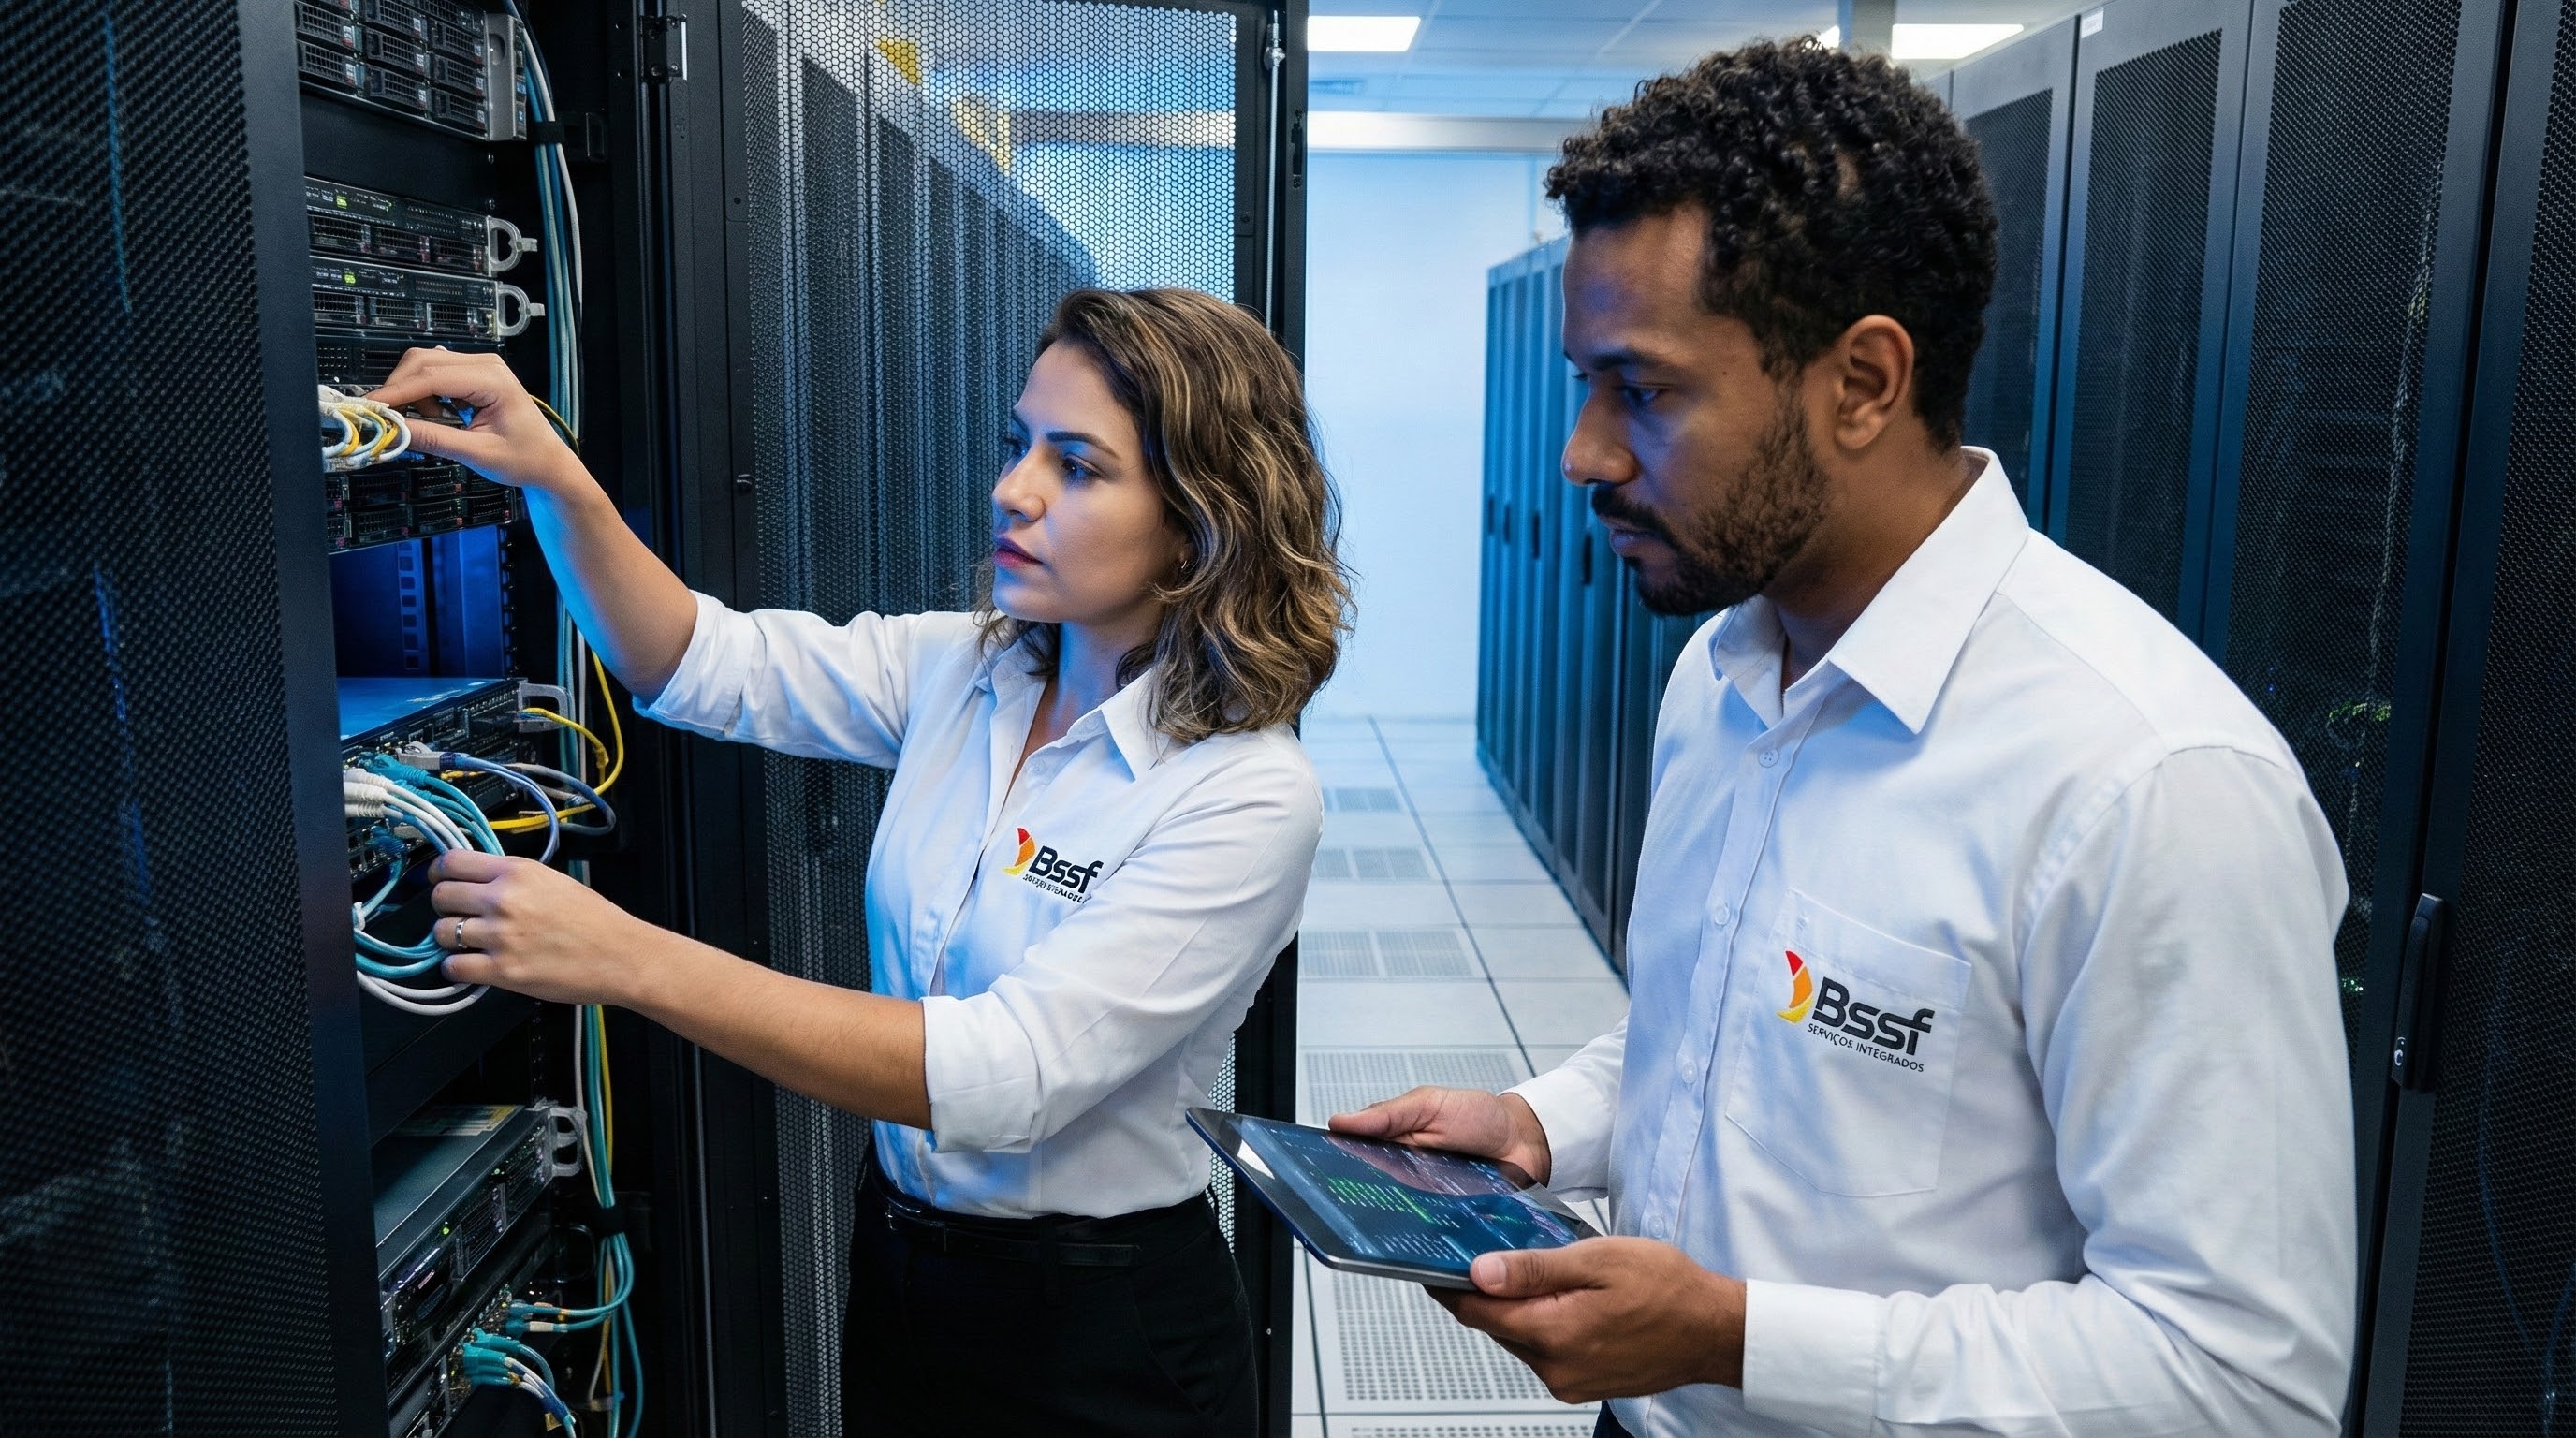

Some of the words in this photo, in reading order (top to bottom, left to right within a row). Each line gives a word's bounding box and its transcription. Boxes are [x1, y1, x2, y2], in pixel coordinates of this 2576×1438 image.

[1029, 845, 1104, 894] Bssf
[1812, 976, 1936, 1056] Bssf
[1807, 1023, 1853, 1049] SERVIÇOS
[1855, 1042, 1925, 1073] INTEGRADOS
